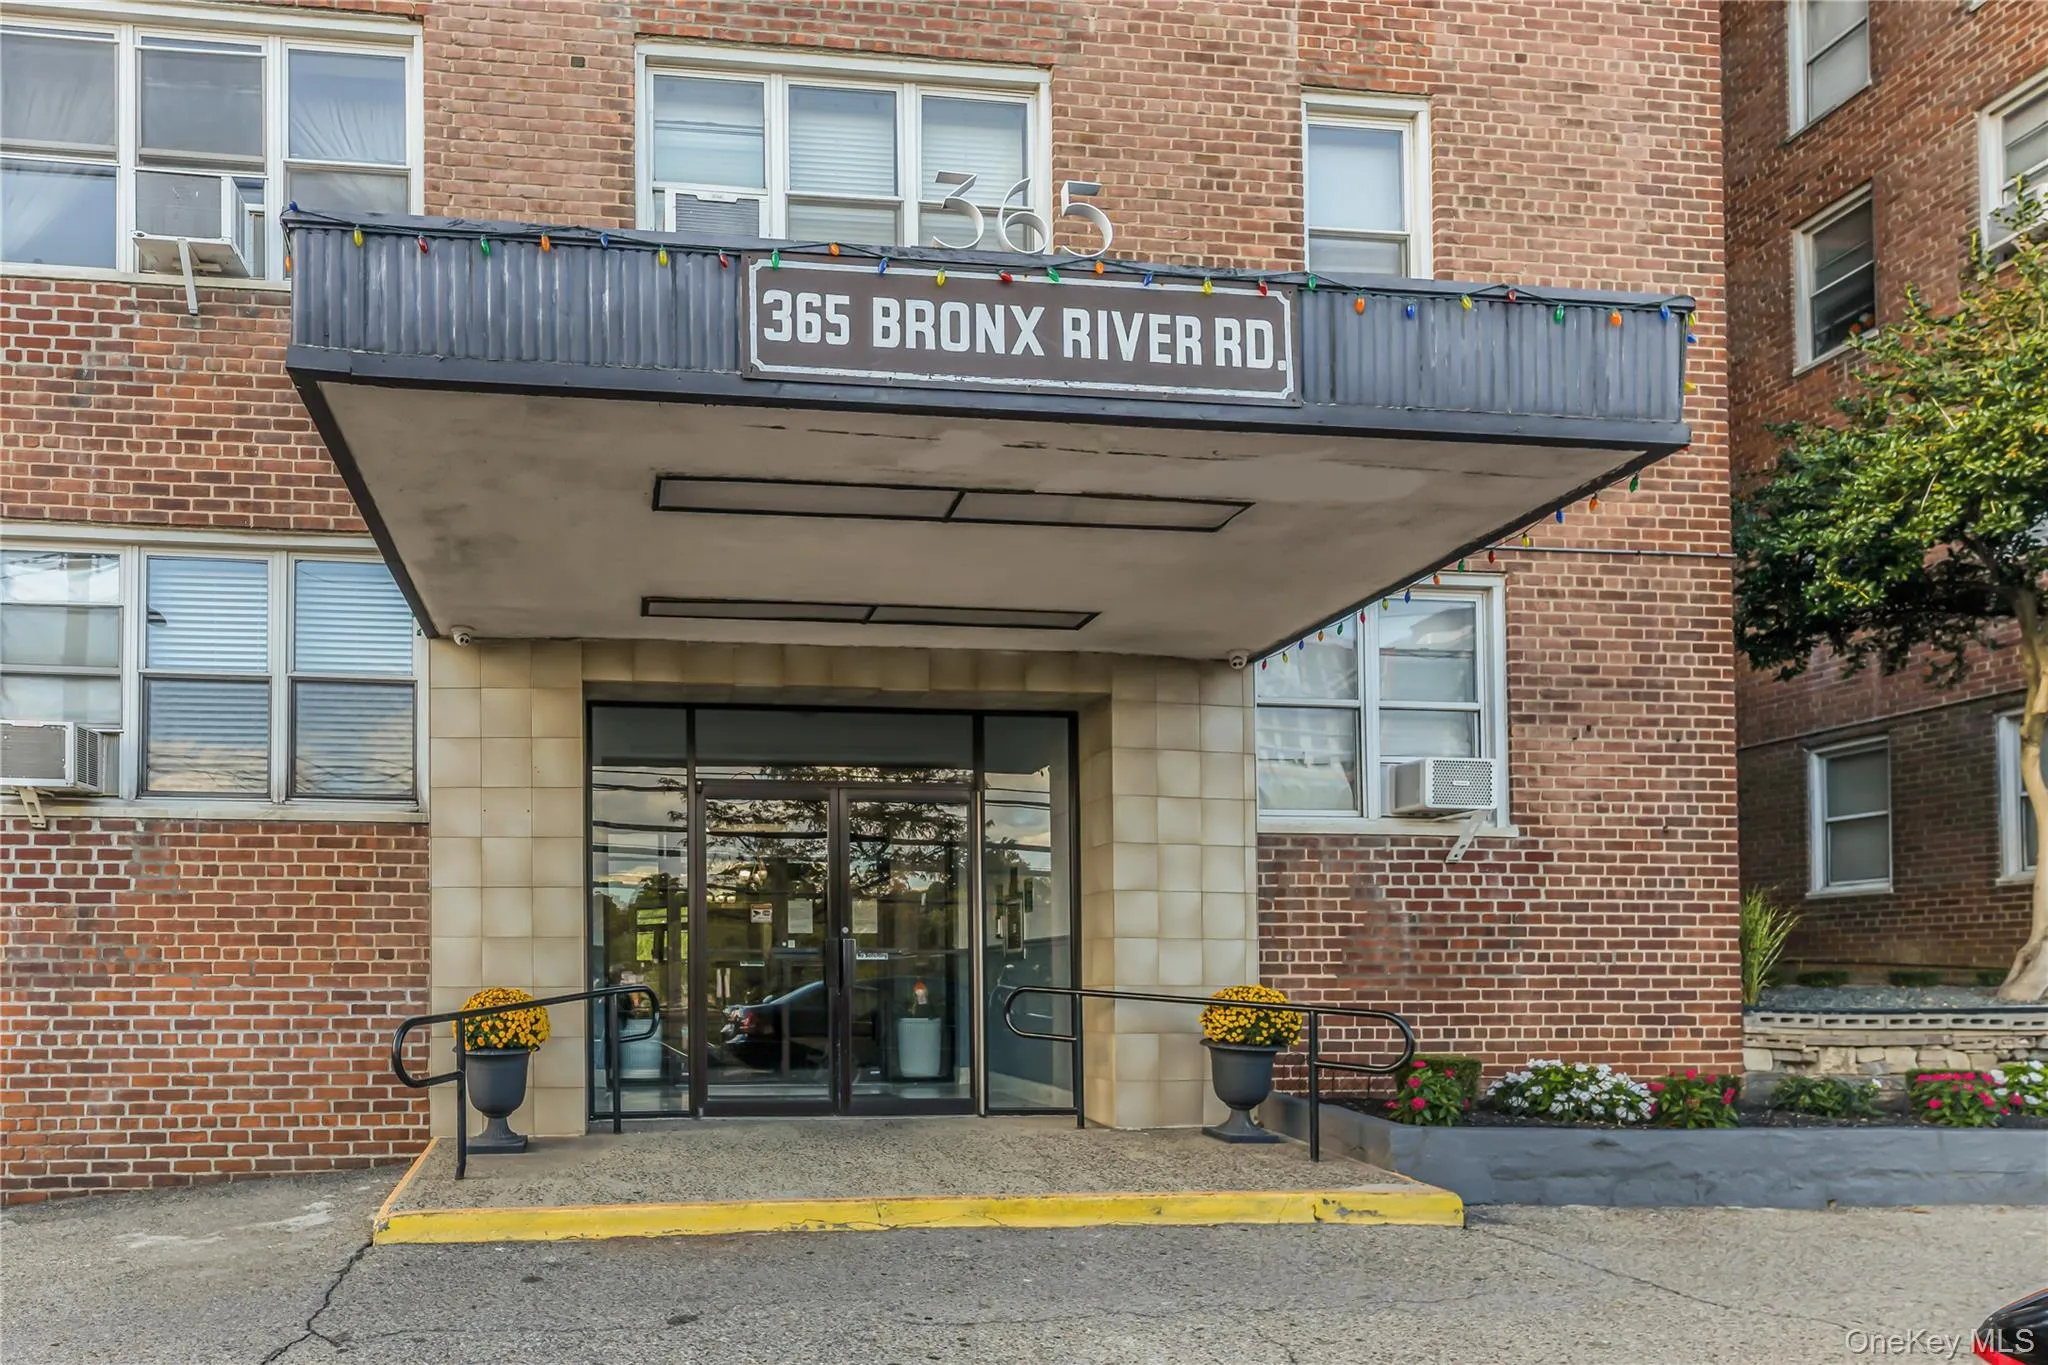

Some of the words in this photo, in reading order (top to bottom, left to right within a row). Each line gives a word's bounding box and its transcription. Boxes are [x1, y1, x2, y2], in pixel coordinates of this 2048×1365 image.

[932, 170, 1113, 257] 365
[762, 290, 850, 345] 365
[872, 297, 1046, 357] BRONX
[1062, 307, 1203, 366] RIVER
[1214, 317, 1287, 371] RD.
